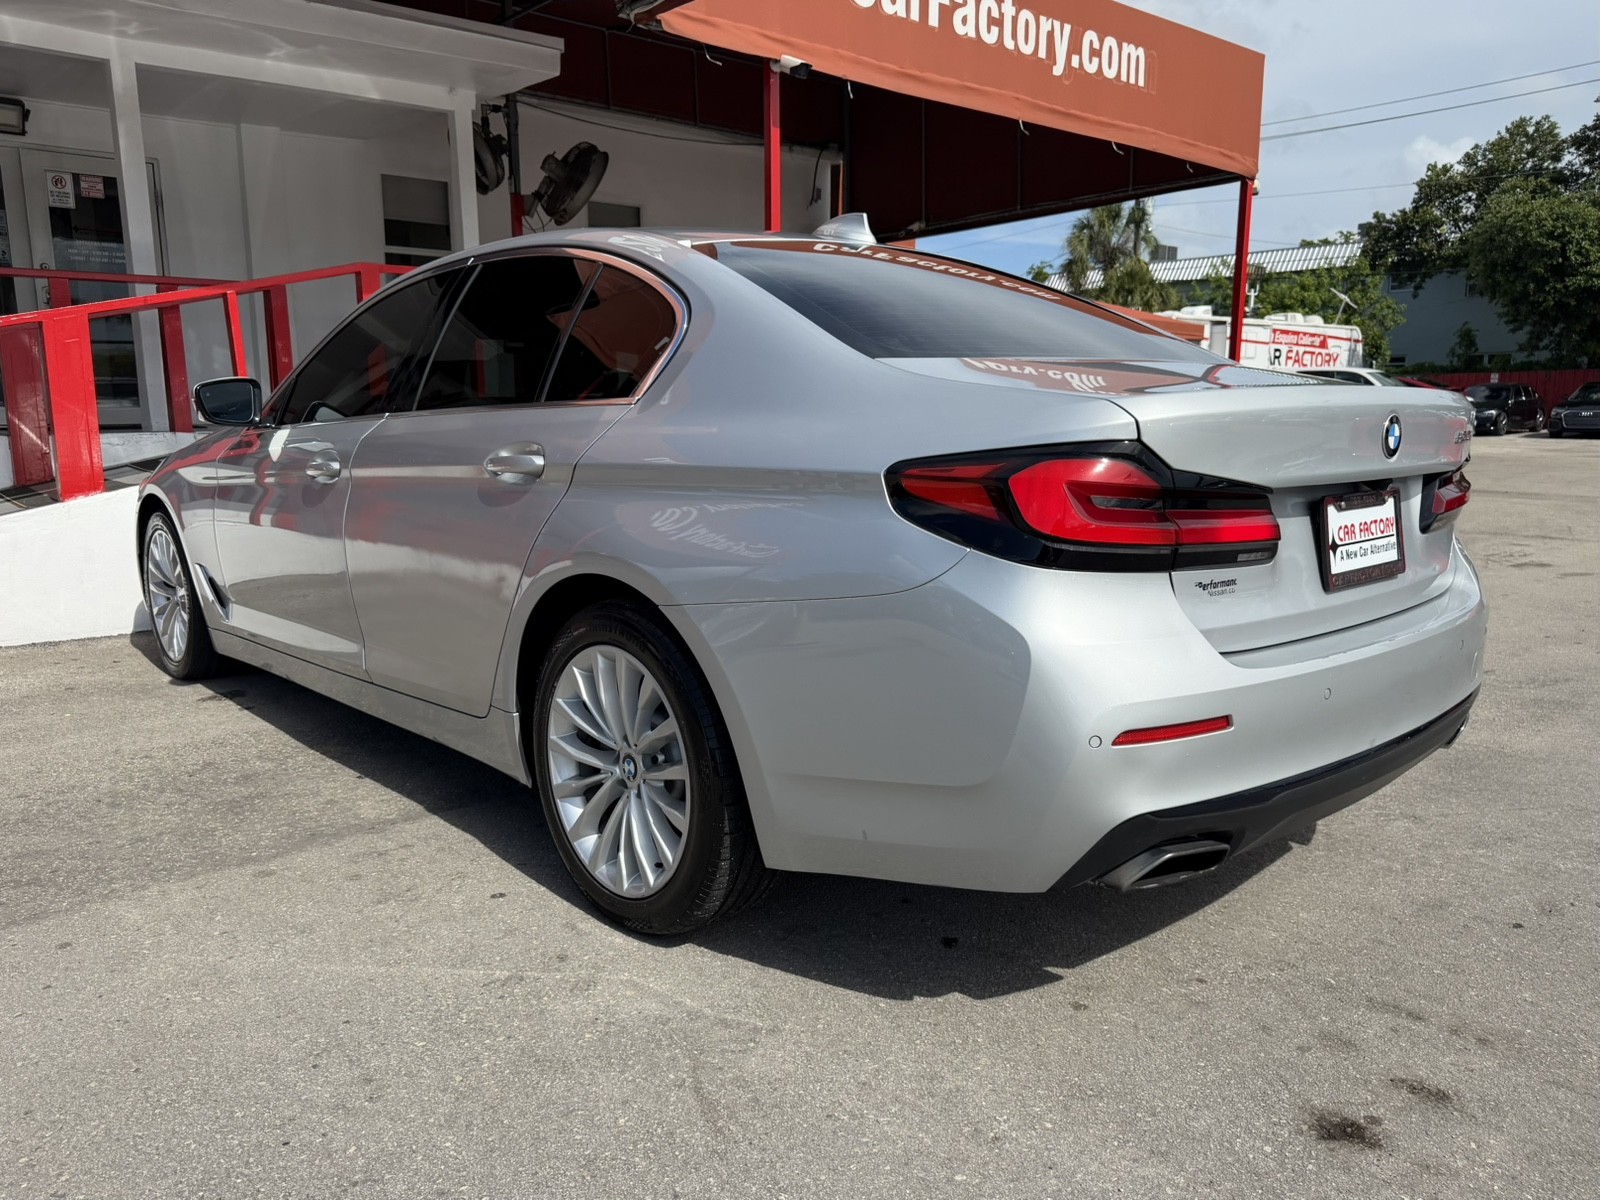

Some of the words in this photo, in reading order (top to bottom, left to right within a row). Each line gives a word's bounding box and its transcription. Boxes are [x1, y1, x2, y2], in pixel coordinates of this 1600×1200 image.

[851, 0, 1145, 87] actory.com
[1285, 349, 1339, 367] FACTORY
[1338, 523, 1356, 542] CAR
[1359, 517, 1394, 538] FACTORY
[1340, 550, 1345, 561] A
[1346, 548, 1358, 560] New
[1359, 545, 1369, 558] Car
[1370, 541, 1396, 555] Alternative
